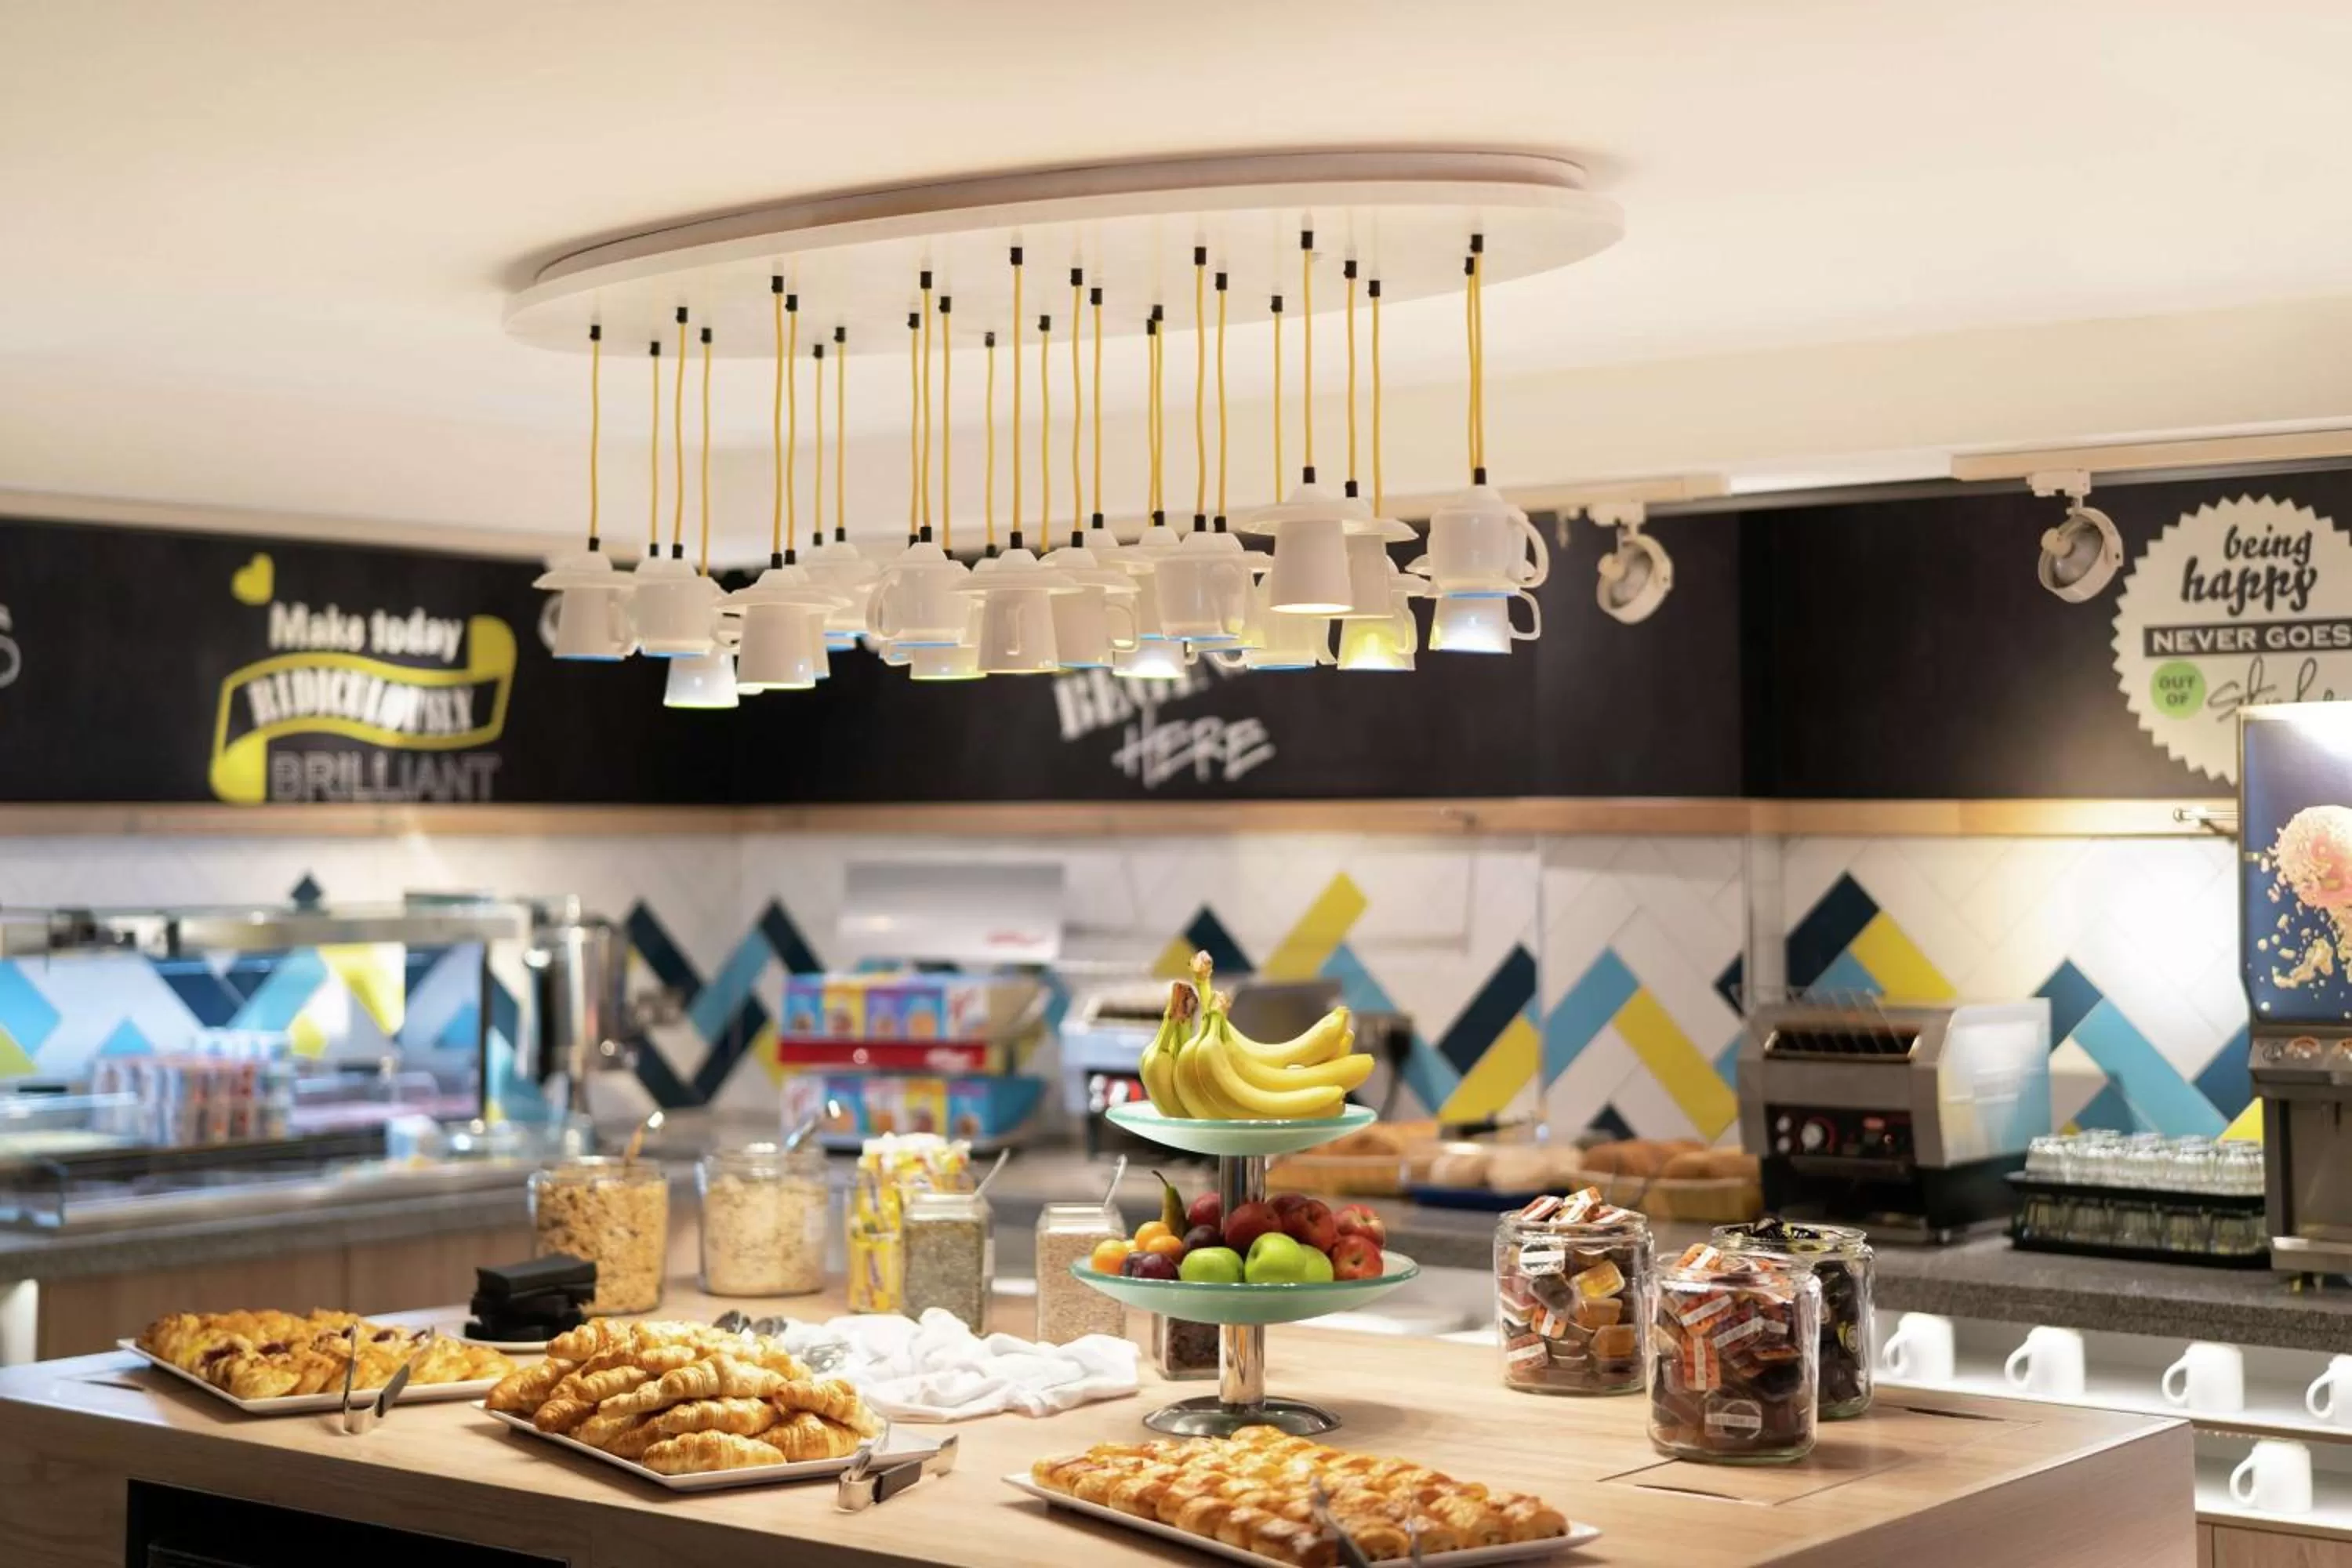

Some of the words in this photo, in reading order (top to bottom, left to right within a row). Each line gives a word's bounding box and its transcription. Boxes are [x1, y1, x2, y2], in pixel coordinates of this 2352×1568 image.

[2224, 523, 2313, 566] being
[2181, 555, 2318, 617] happy
[269, 601, 365, 652] Make
[370, 607, 463, 663] today
[2153, 628, 2257, 653] NEVER
[2265, 624, 2352, 649] GOES
[2159, 674, 2195, 690] OUT
[2165, 692, 2190, 707] OF
[1110, 702, 1277, 790] HERE
[272, 750, 502, 804] BRILLIANT
